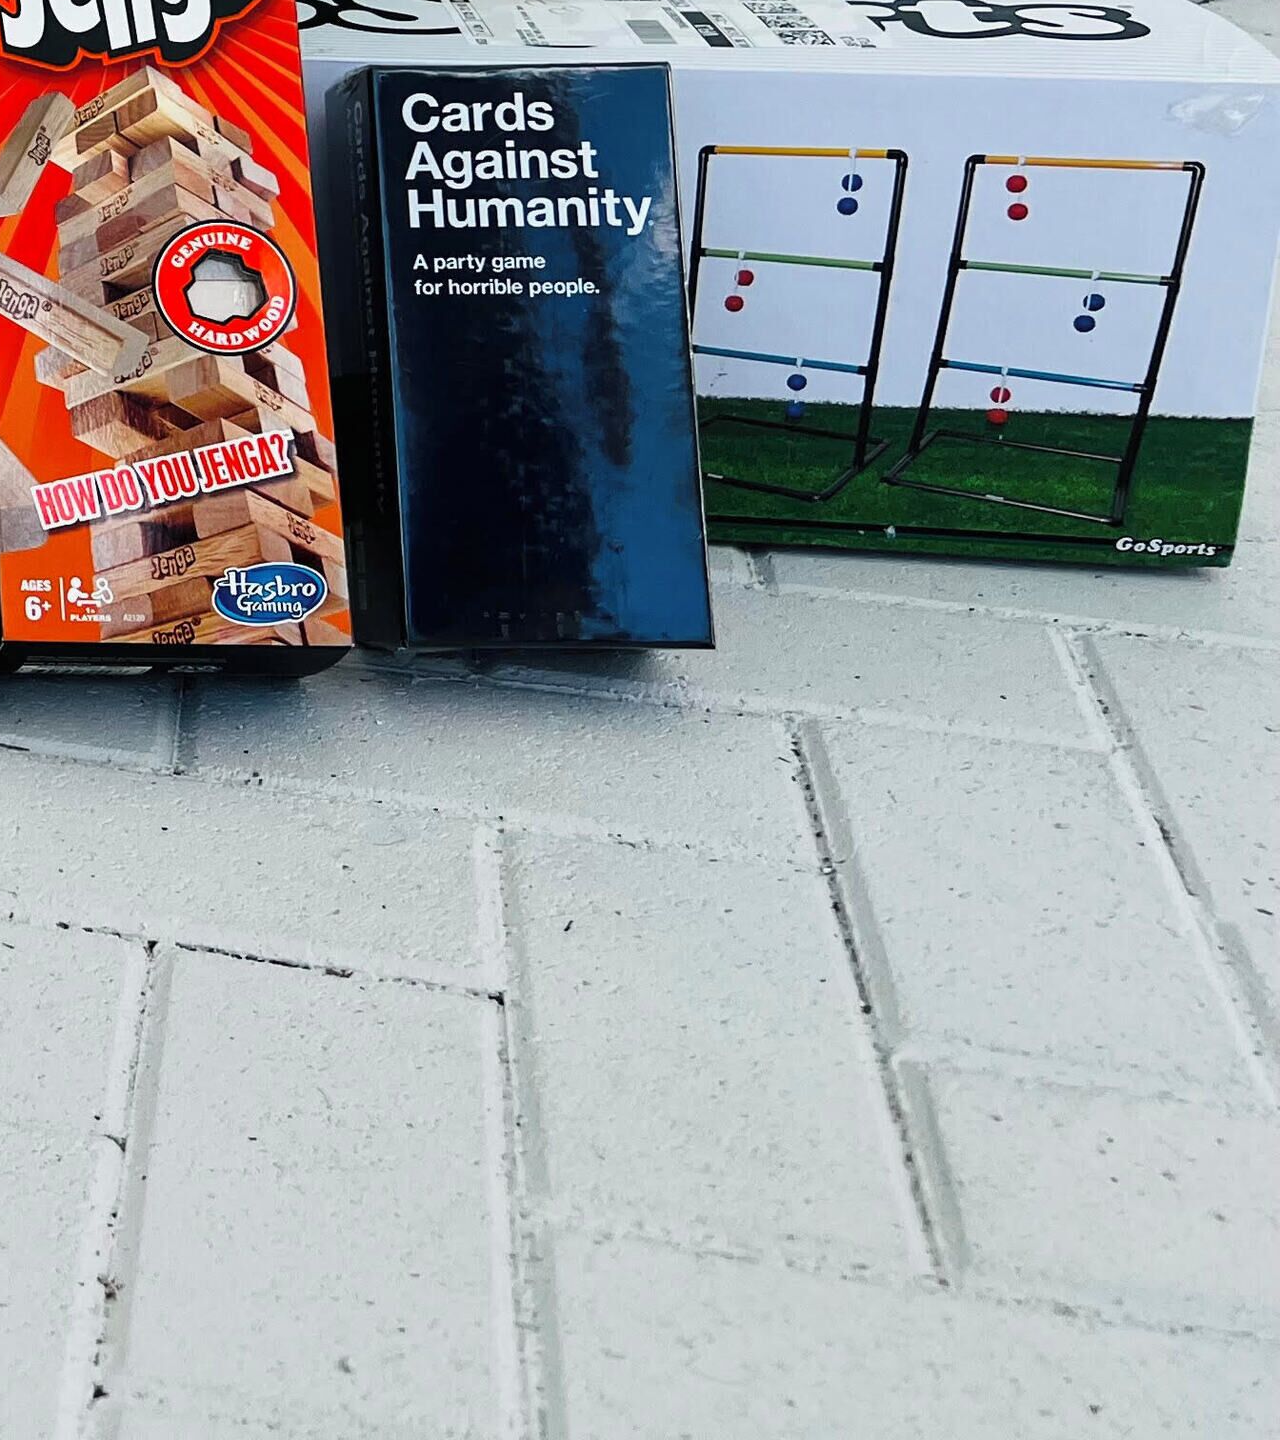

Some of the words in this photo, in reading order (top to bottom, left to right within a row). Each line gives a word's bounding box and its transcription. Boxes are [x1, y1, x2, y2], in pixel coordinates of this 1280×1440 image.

[401, 92, 555, 133] Cards
[405, 140, 599, 190] Against
[408, 187, 653, 236] Humanity
[170, 231, 252, 269] GENUINE
[413, 254, 428, 270] A
[434, 254, 485, 273] party
[491, 256, 546, 273] game
[414, 279, 443, 295] for
[448, 278, 523, 295] horrible
[529, 278, 600, 298] people.
[113, 291, 149, 320] Jenga
[187, 295, 285, 347] HARDWOOD
[35, 477, 97, 526] HOW
[100, 468, 139, 512] DO
[140, 455, 195, 500] YOU
[198, 433, 290, 489] JENGA?
[1116, 537, 1216, 556] GoSports
[152, 545, 195, 581] Jenga
[21, 579, 52, 591] AGES
[218, 571, 316, 600] Hasbro
[25, 596, 52, 621] 6+
[70, 614, 111, 622] PLAYERS
[237, 596, 306, 619] Gaming
